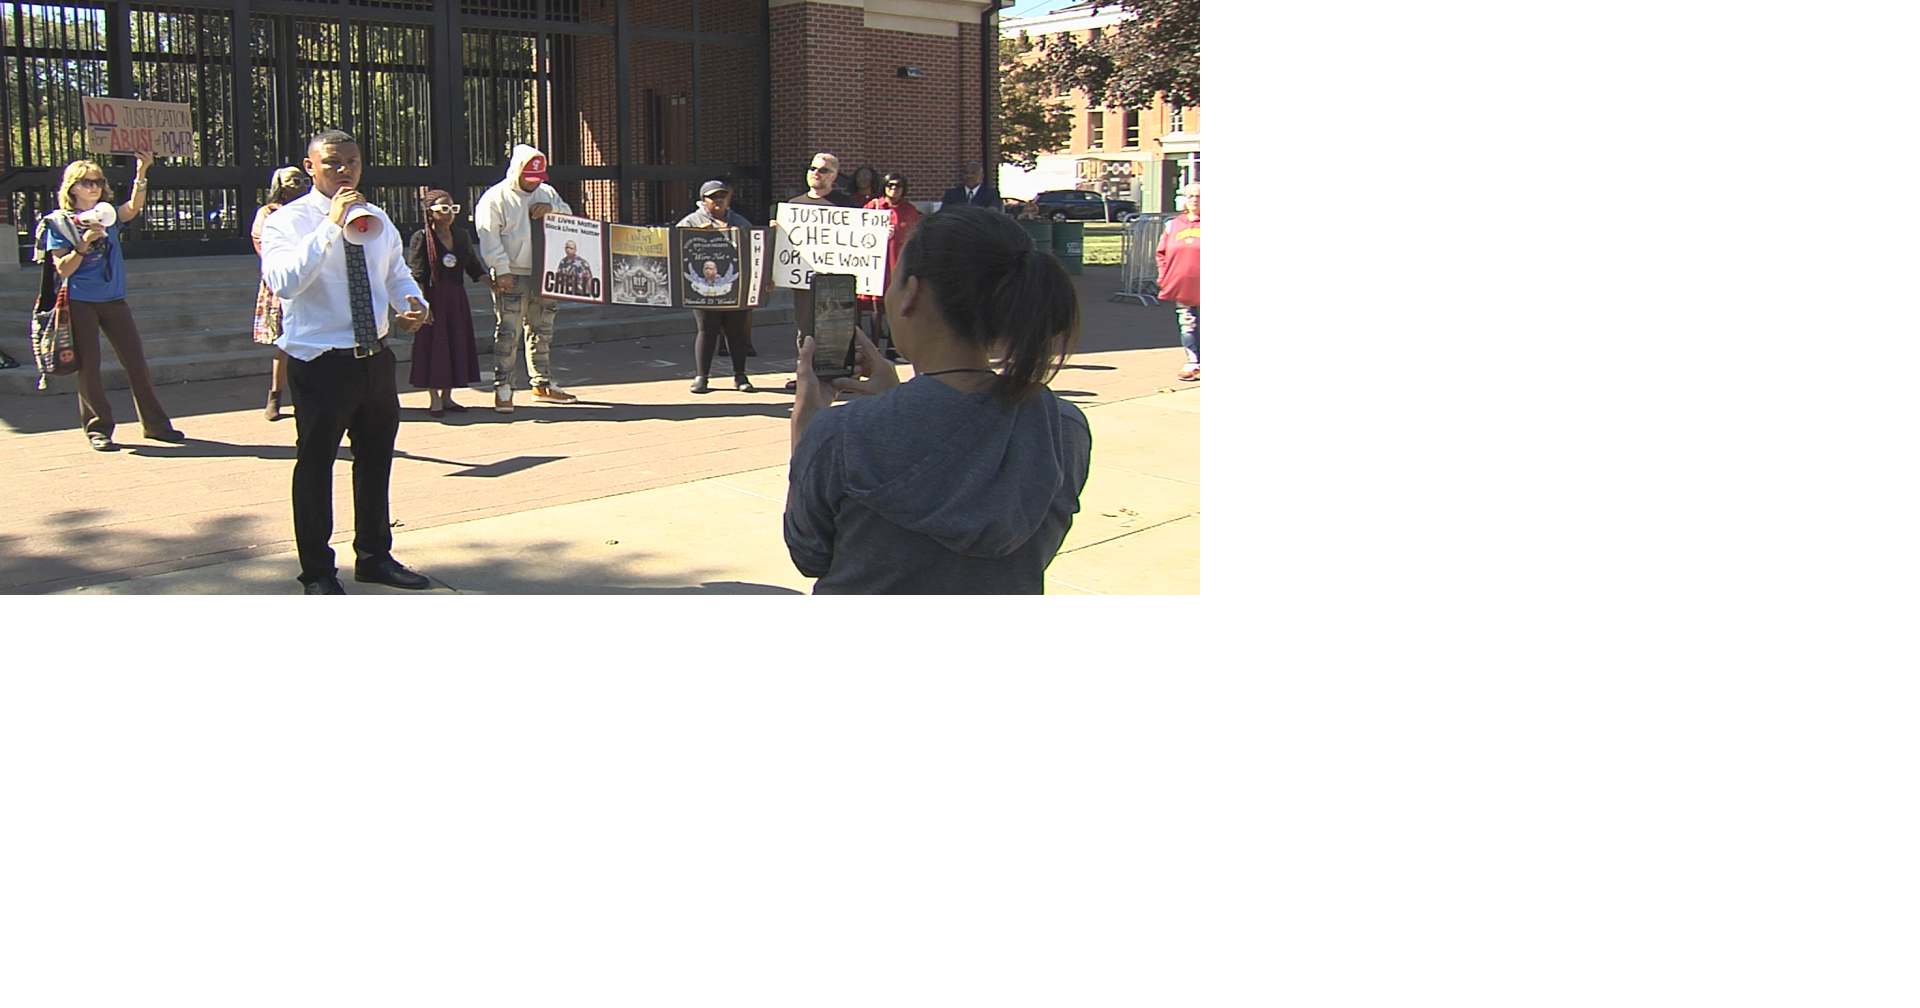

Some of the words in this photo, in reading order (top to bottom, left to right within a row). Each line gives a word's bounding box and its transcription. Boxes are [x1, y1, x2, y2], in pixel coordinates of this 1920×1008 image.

[86, 102, 115, 125] NO
[122, 106, 190, 129] JUSTIFICATION
[162, 131, 192, 155] POWER
[557, 217, 576, 225] Lives
[577, 220, 599, 229] Matter
[788, 207, 850, 226] JUSTICE
[861, 212, 890, 227] FOR
[788, 226, 877, 249] CHELLO
[779, 249, 801, 265] OR
[812, 251, 835, 265] WE
[838, 252, 882, 270] WONT
[544, 271, 600, 298] CHELLO
[633, 276, 647, 286] RIP
